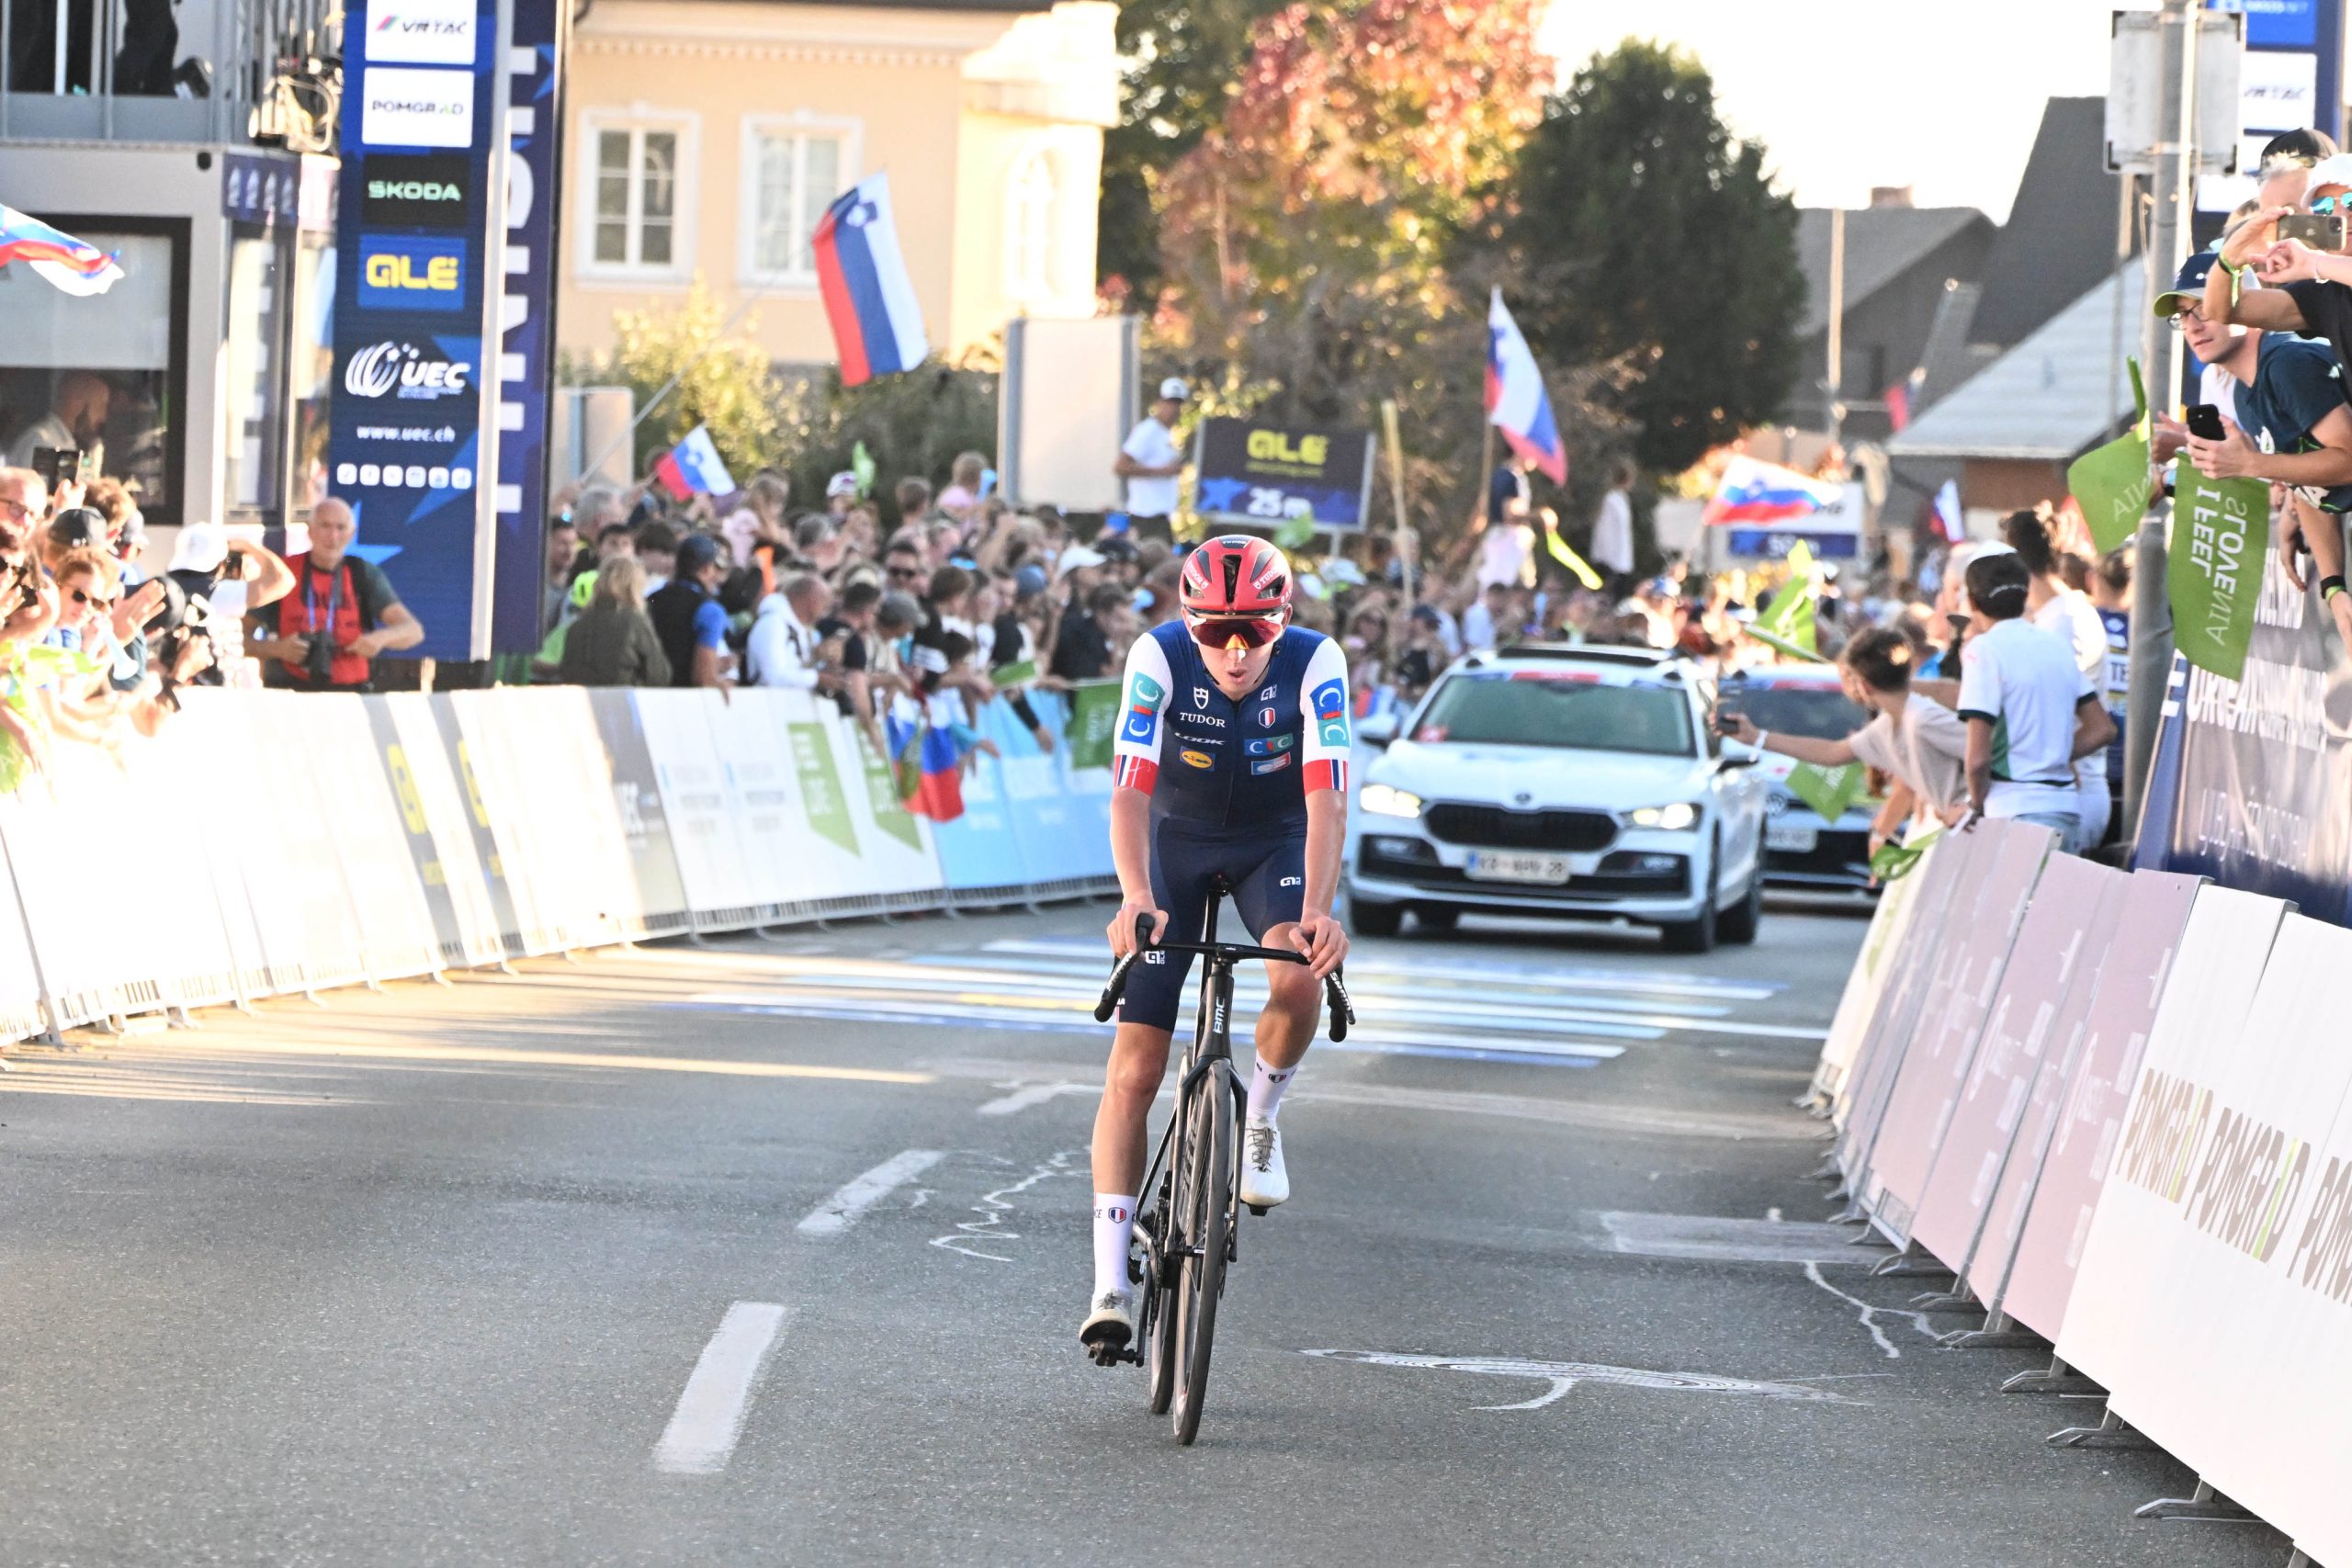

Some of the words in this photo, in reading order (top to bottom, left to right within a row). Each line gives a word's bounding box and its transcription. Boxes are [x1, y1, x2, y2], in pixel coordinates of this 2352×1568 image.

[371, 100, 464, 115] POMGRAD
[356, 424, 456, 443] www.uec.ch
[1180, 712, 1227, 728] TUDOR
[1174, 732, 1227, 746] LOOK
[1250, 737, 1290, 754] CIC
[1213, 996, 1227, 1035] BMC
[2116, 1067, 2213, 1205] POMGRAD
[2184, 1106, 2311, 1264] POMGRAD
